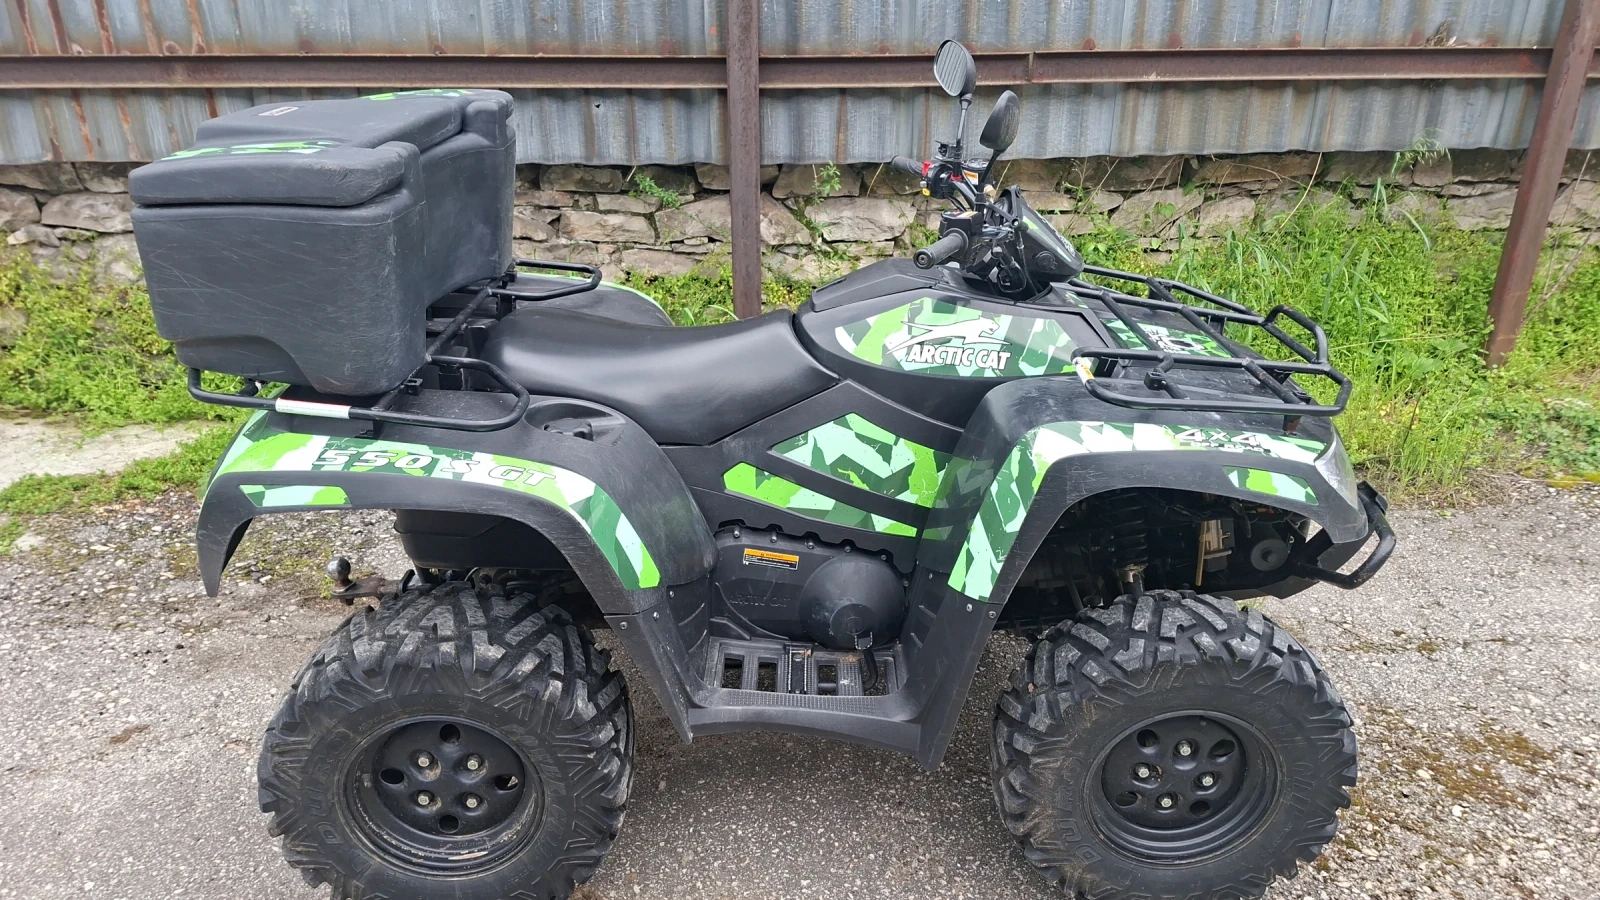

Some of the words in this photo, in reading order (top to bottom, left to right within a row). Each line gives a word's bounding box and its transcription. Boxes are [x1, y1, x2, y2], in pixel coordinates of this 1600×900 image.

[906, 344, 975, 367] ARCTIC
[975, 349, 1011, 370] CAT
[312, 449, 434, 469] 550
[440, 459, 481, 474] S
[488, 464, 557, 487] GT
[305, 728, 353, 844] DURO
